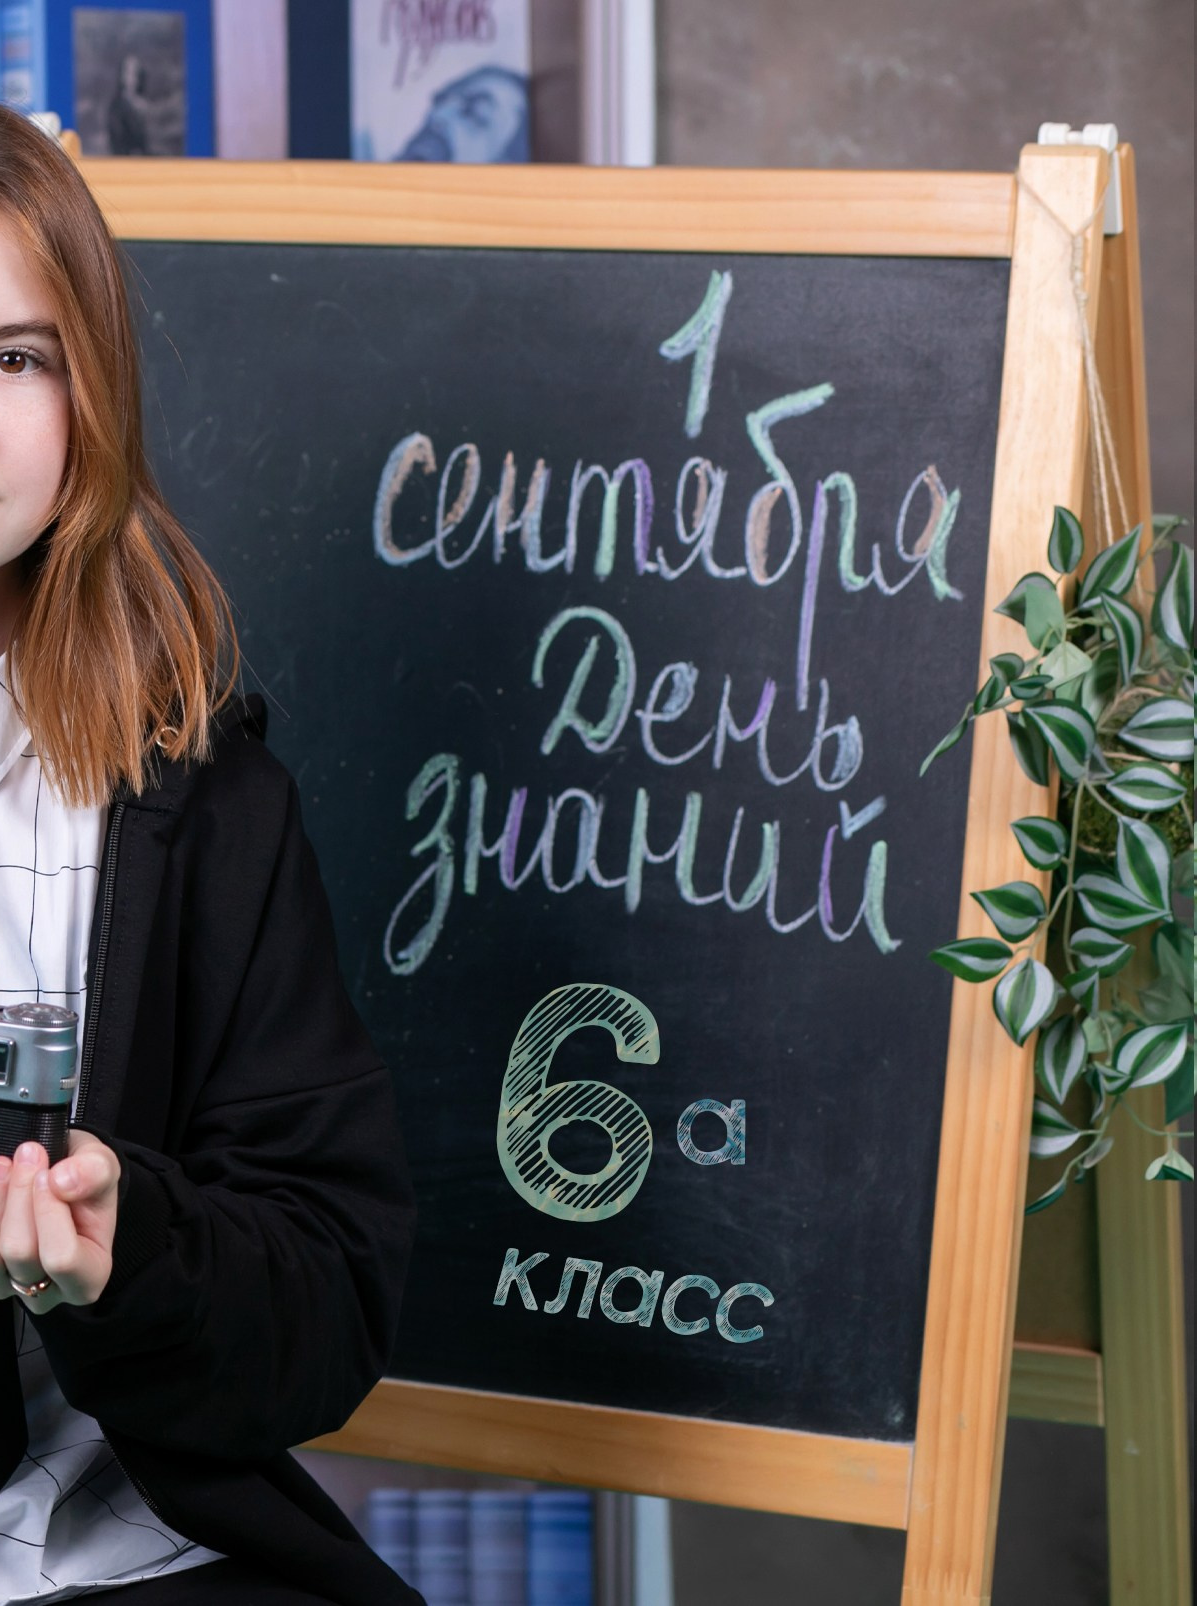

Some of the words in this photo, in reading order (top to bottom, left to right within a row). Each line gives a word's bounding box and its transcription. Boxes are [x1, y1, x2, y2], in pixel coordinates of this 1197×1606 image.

[658, 270, 733, 438] 1
[373, 381, 964, 711] сентября
[532, 605, 864, 791] День
[384, 753, 904, 976] знаний
